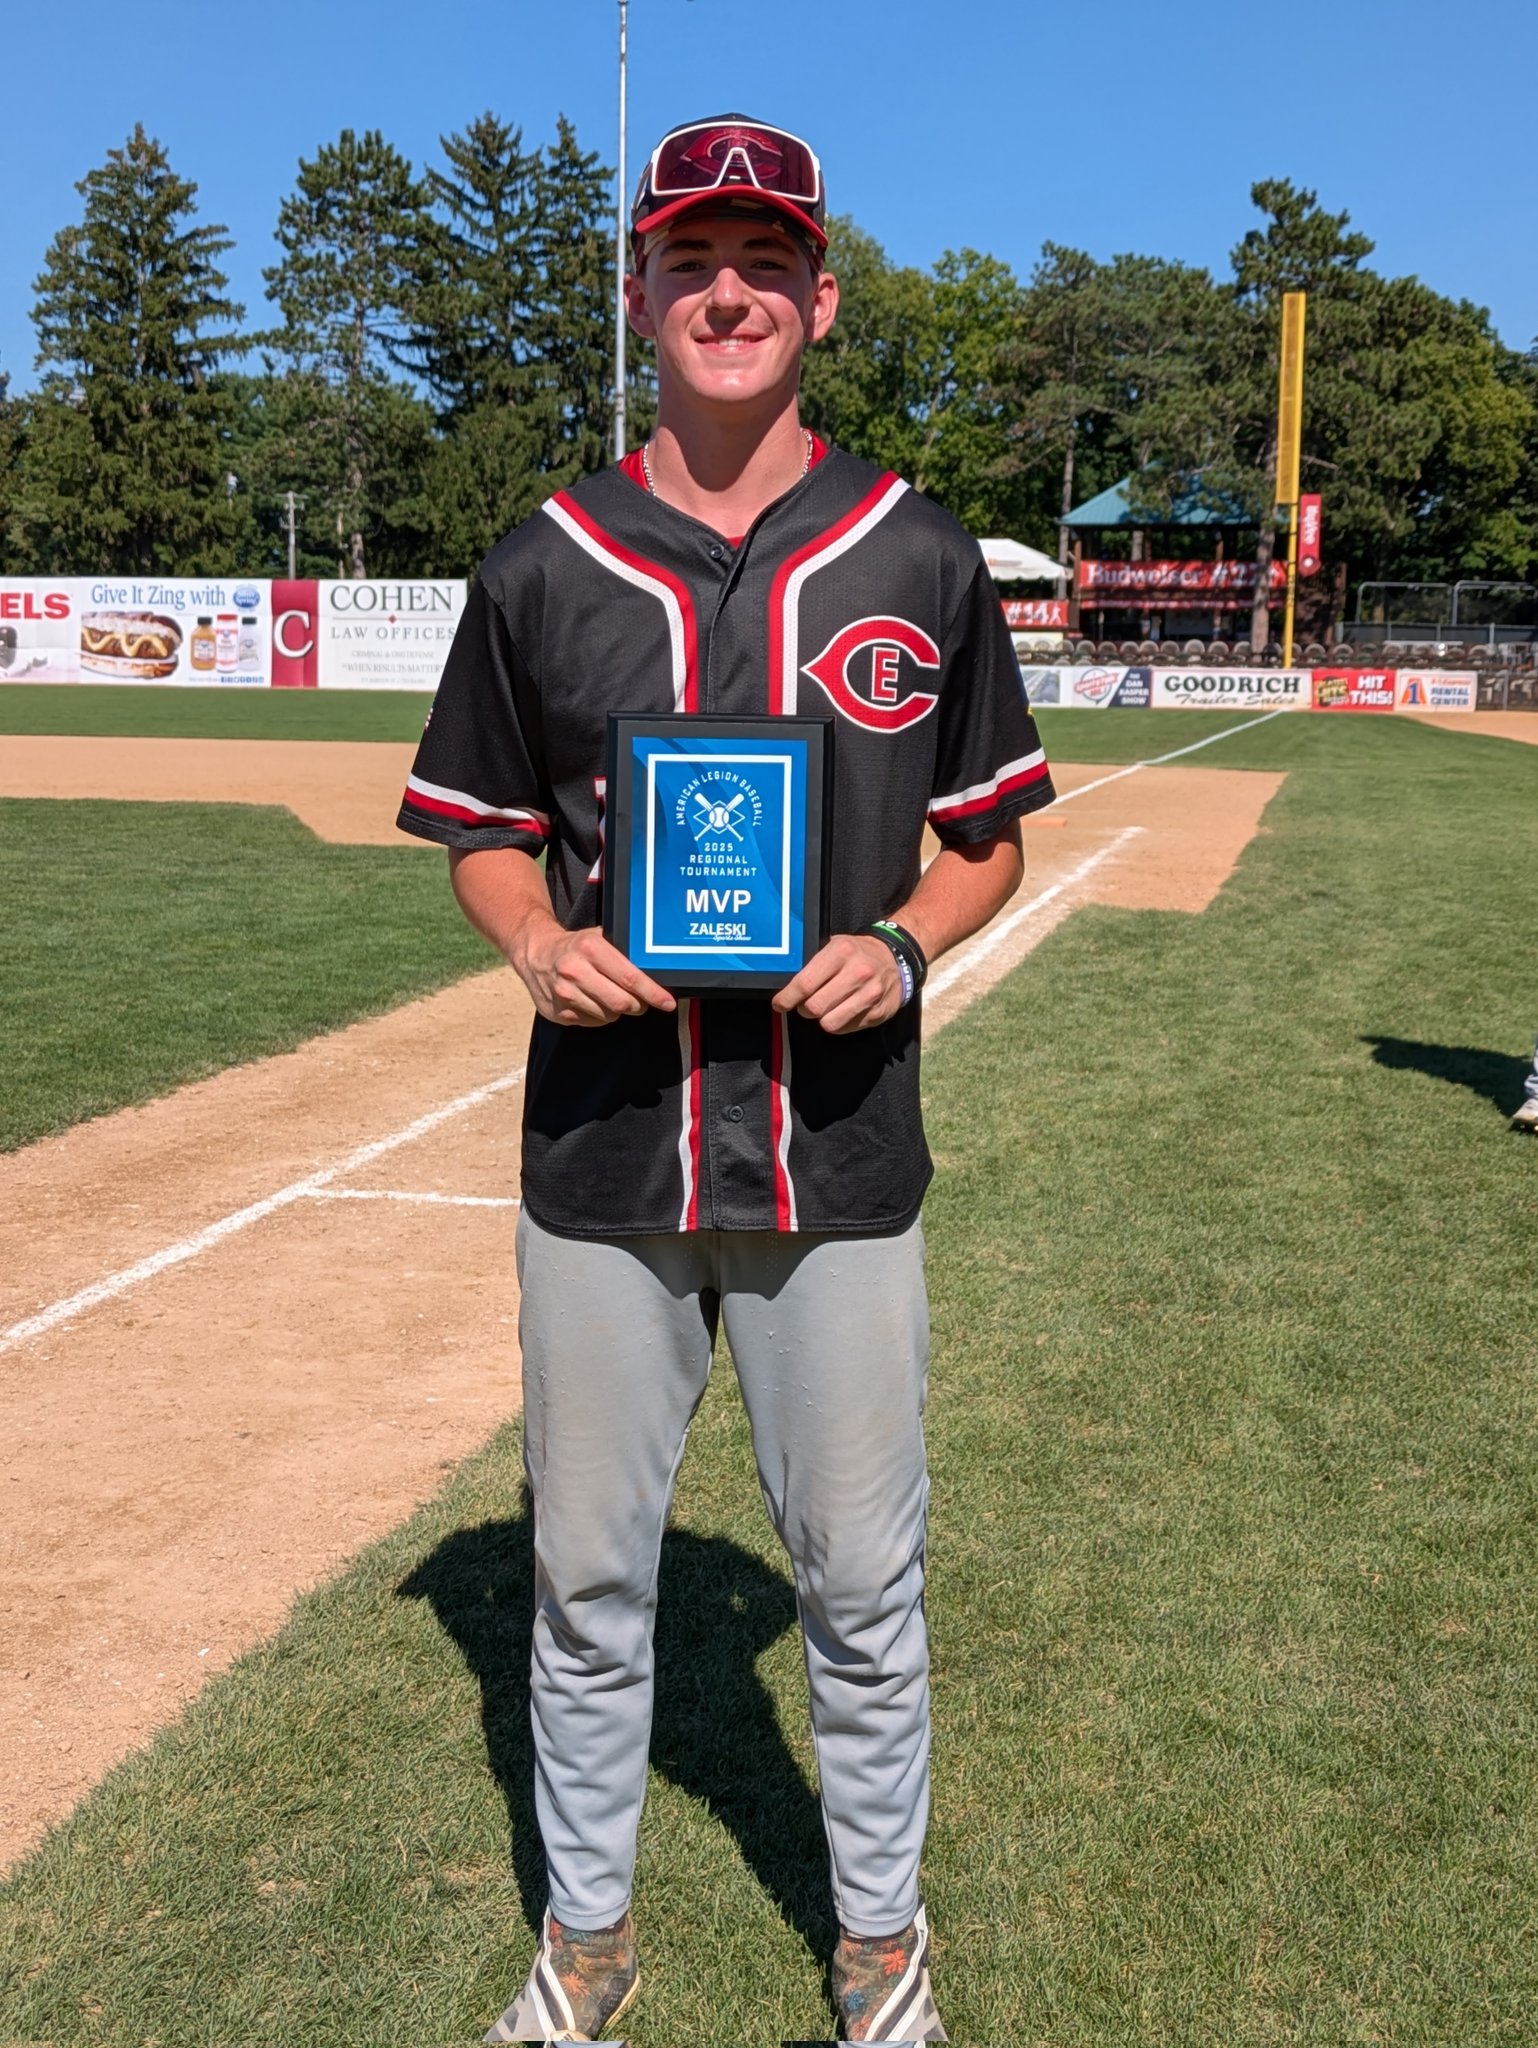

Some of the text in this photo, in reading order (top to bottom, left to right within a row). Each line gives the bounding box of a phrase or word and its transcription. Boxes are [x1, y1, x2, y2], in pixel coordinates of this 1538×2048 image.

[1088, 563, 1201, 586] Budweiser
[91, 584, 226, 610] Give It Zing with
[330, 585, 455, 612] COHEN
[273, 609, 315, 659] C
[331, 626, 456, 641] LAW OFFICES
[1125, 680, 1143, 688] DAN
[1164, 675, 1301, 693] GOODRICH
[1356, 675, 1387, 690] HIT
[1349, 690, 1394, 706] THIS!
[1430, 687, 1469, 696] RENTAL
[1121, 697, 1146, 705] SHOW
[1175, 693, 1296, 706] Trailer Sales
[1430, 697, 1469, 706] CENTER
[675, 771, 763, 826] AMERICAN LEGION BASEBALL
[704, 843, 734, 852] 2025
[689, 854, 748, 864] REGIONAL
[680, 866, 757, 877] TOURNAMENT
[686, 889, 752, 913] MVP
[689, 922, 747, 936] ZALESKI
